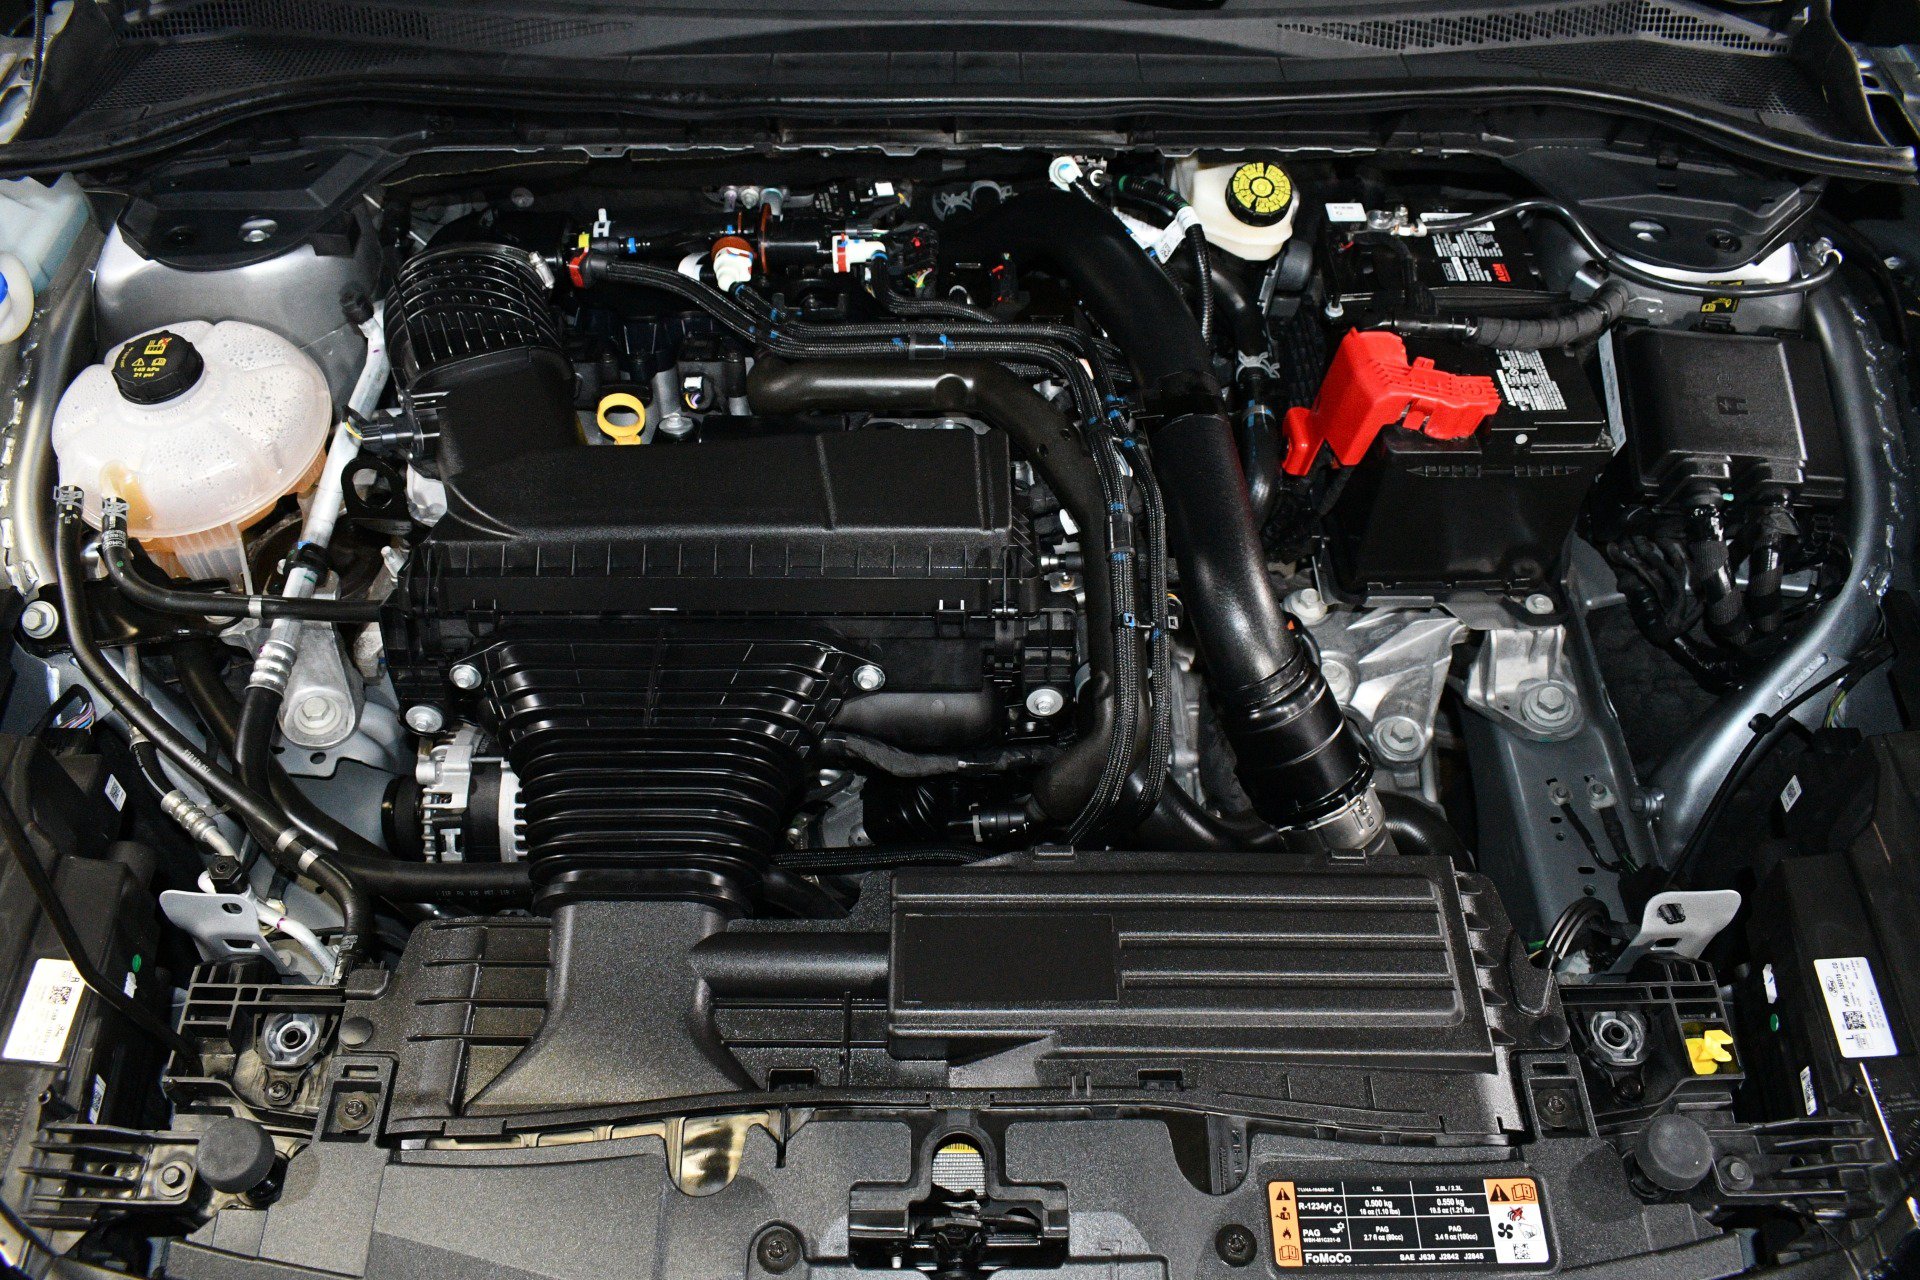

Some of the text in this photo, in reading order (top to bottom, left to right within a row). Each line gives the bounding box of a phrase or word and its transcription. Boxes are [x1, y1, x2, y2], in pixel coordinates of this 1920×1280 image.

[1298, 1202, 1332, 1211] R-1234yf
[1384, 1200, 1393, 1208] kg
[1456, 1198, 1464, 1207] kg
[1305, 1253, 1352, 1263] FoMoCo
